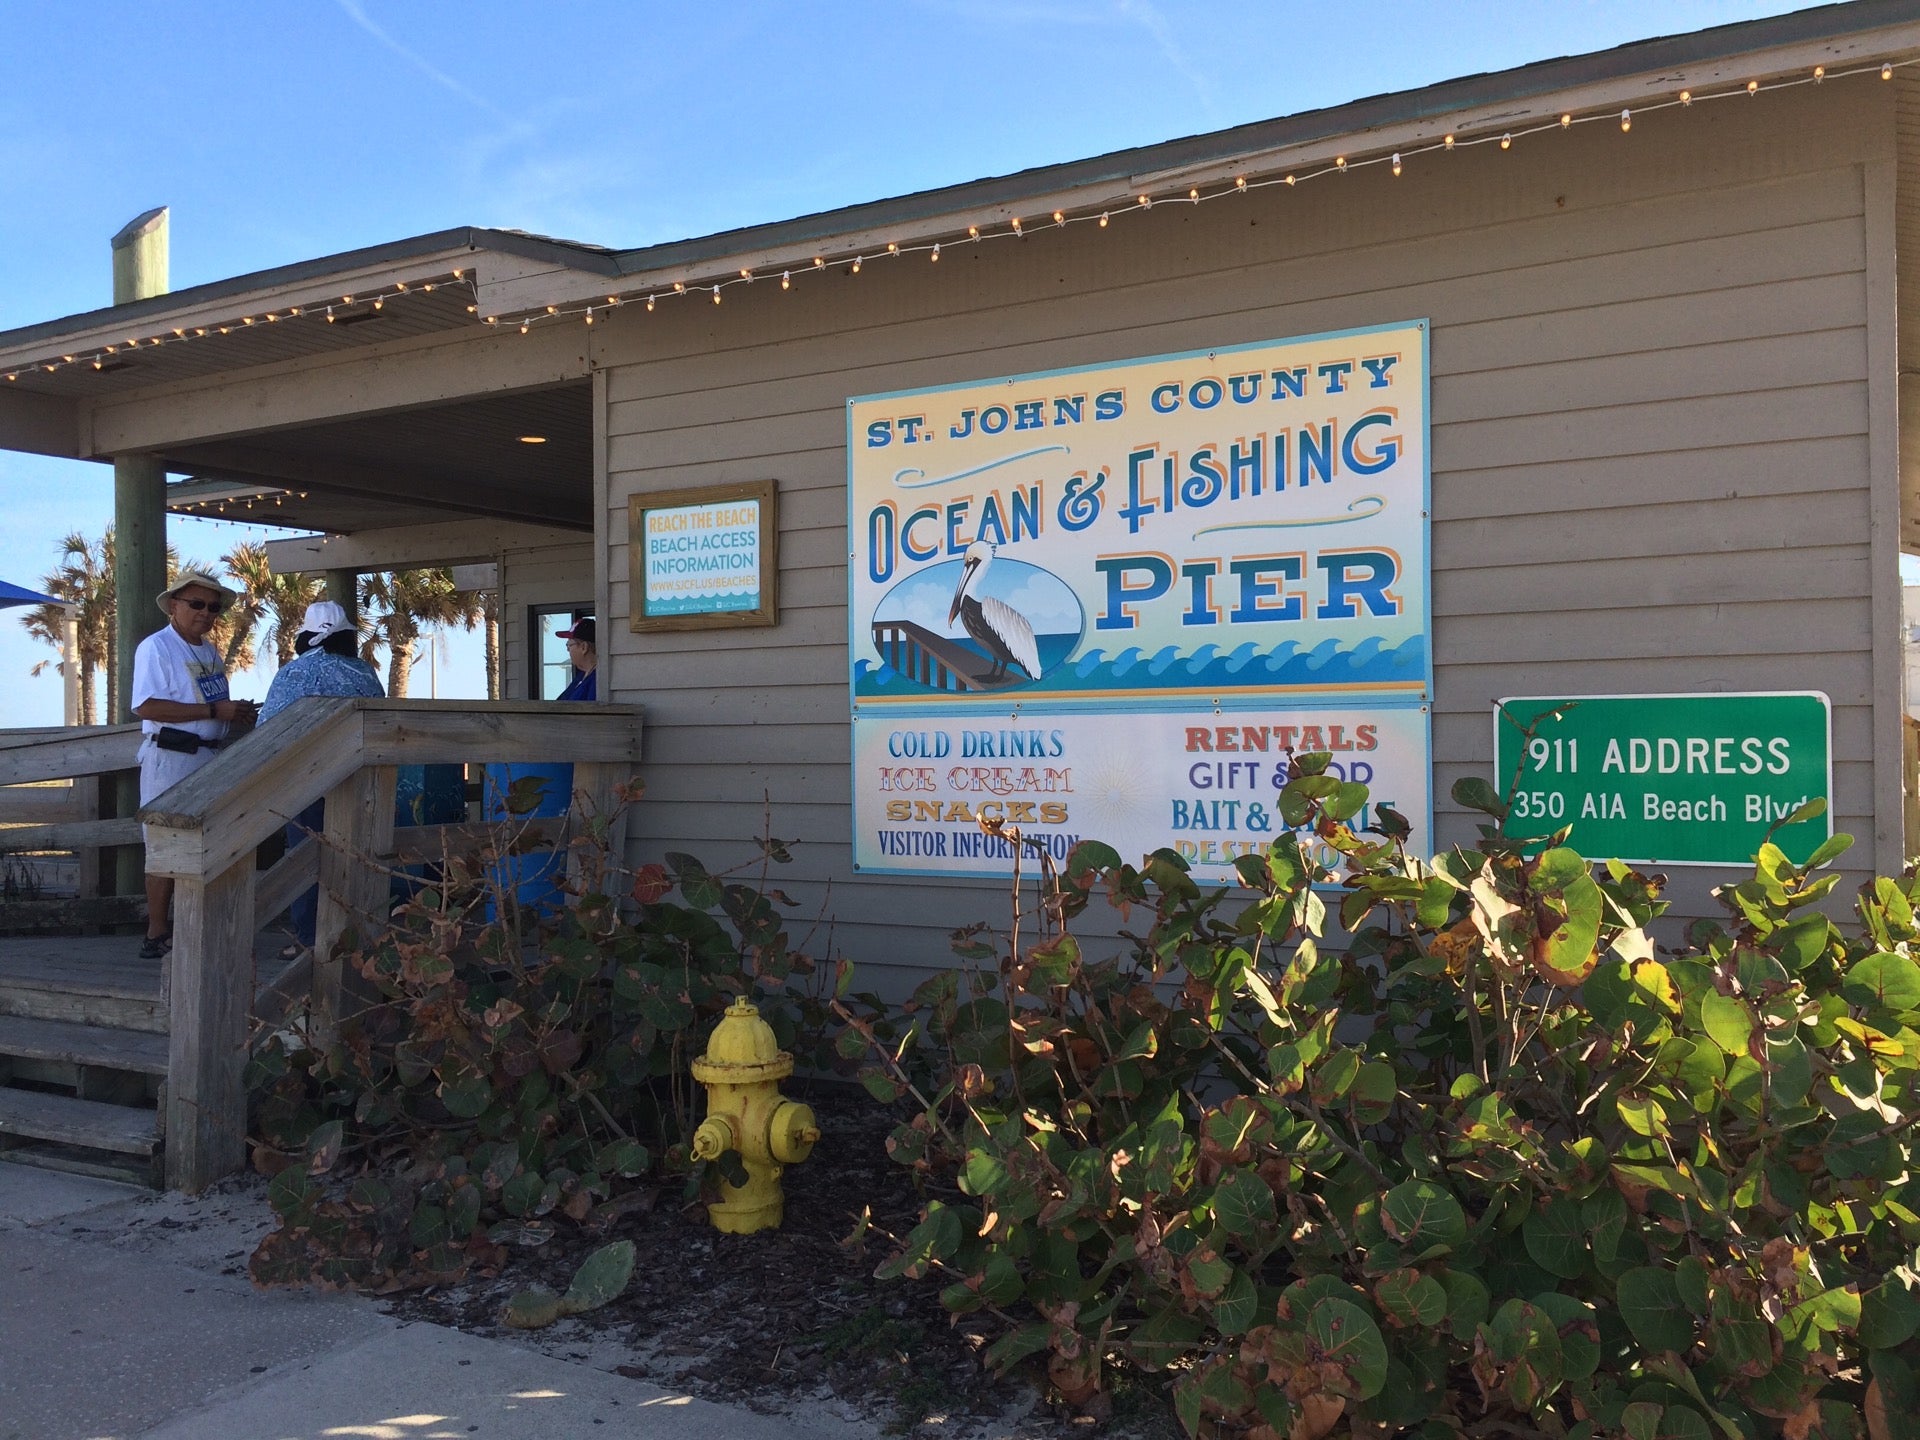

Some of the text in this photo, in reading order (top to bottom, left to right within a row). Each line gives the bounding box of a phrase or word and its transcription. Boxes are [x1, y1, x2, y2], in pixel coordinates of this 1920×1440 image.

[867, 353, 1402, 448] ST. JOHNS COUNTY
[868, 407, 1403, 583] OCEAN & FISHING
[649, 507, 756, 533] REACH THE BEACH
[651, 531, 756, 554] BEACH ACCESS
[652, 552, 754, 575] INFORMATION
[1095, 546, 1403, 631] PIER
[888, 729, 1065, 758] COLD DRINKS
[1184, 724, 1378, 753] RENTALS
[1527, 737, 1791, 775] 911 ADDRESS
[879, 766, 1074, 795] ICE CREAM
[1188, 761, 1374, 790] GIFT SP
[886, 799, 1069, 824] SNACKS
[1171, 798, 1242, 830] BAIT
[1245, 801, 1273, 833] &
[1514, 791, 1565, 819] 350
[1580, 792, 1627, 820] A1A
[1643, 793, 1727, 822] Beach
[878, 830, 1080, 861] VISITOR INFORATIO
